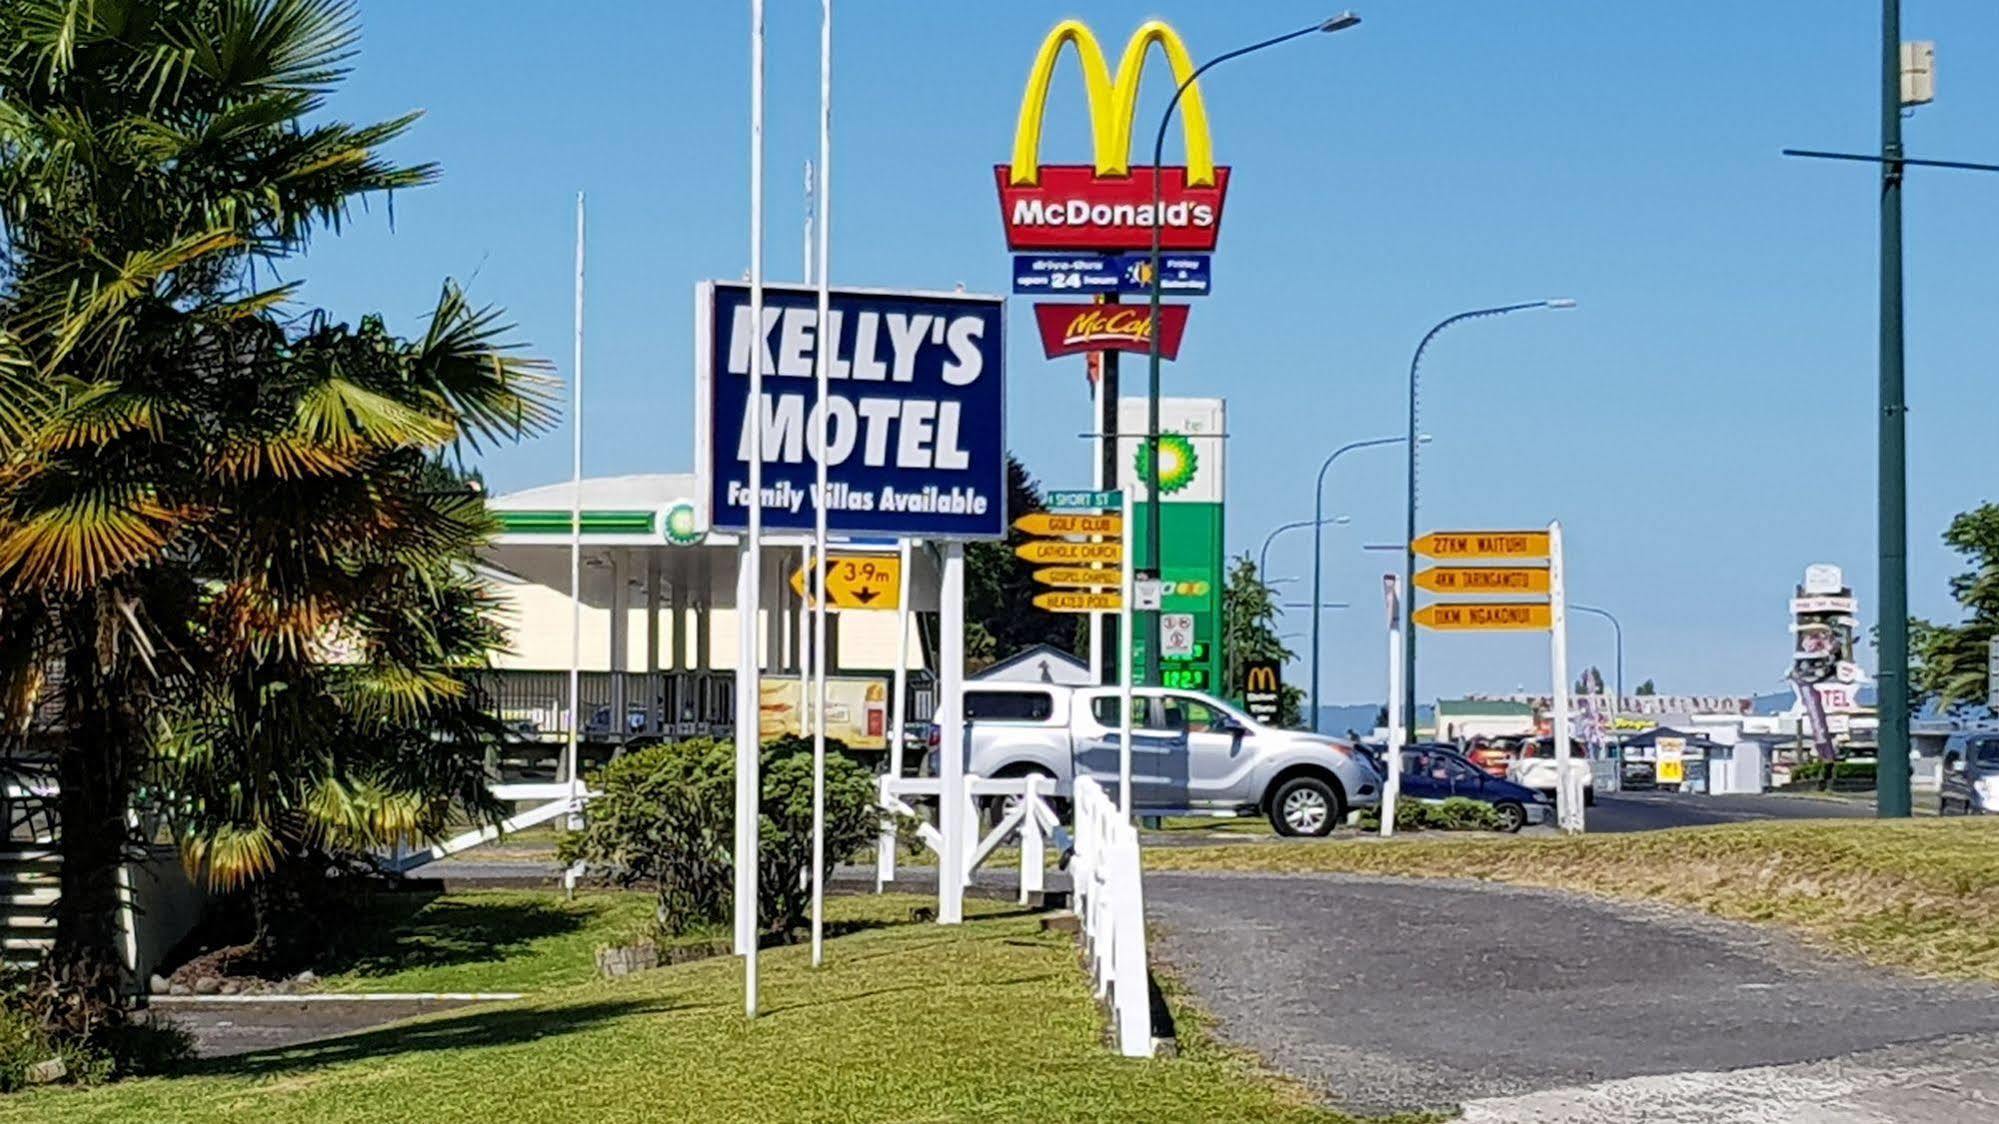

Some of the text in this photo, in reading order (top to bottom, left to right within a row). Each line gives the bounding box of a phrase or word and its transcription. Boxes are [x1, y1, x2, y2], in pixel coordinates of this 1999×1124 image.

[1012, 200, 1213, 227] McDonald's
[1051, 273, 1082, 289] 24
[727, 305, 985, 385] KELLY'S
[737, 393, 969, 470] MOTEL
[879, 486, 987, 514] Available
[1056, 493, 1109, 506] SHORT ST
[1049, 518, 1111, 531] GOLF CLUB
[1036, 546, 1117, 558] CATHOLIC CHURCH
[1433, 537, 1467, 553] 27KM
[1434, 572, 1456, 587] 4KM
[1087, 596, 1110, 608] POOL
